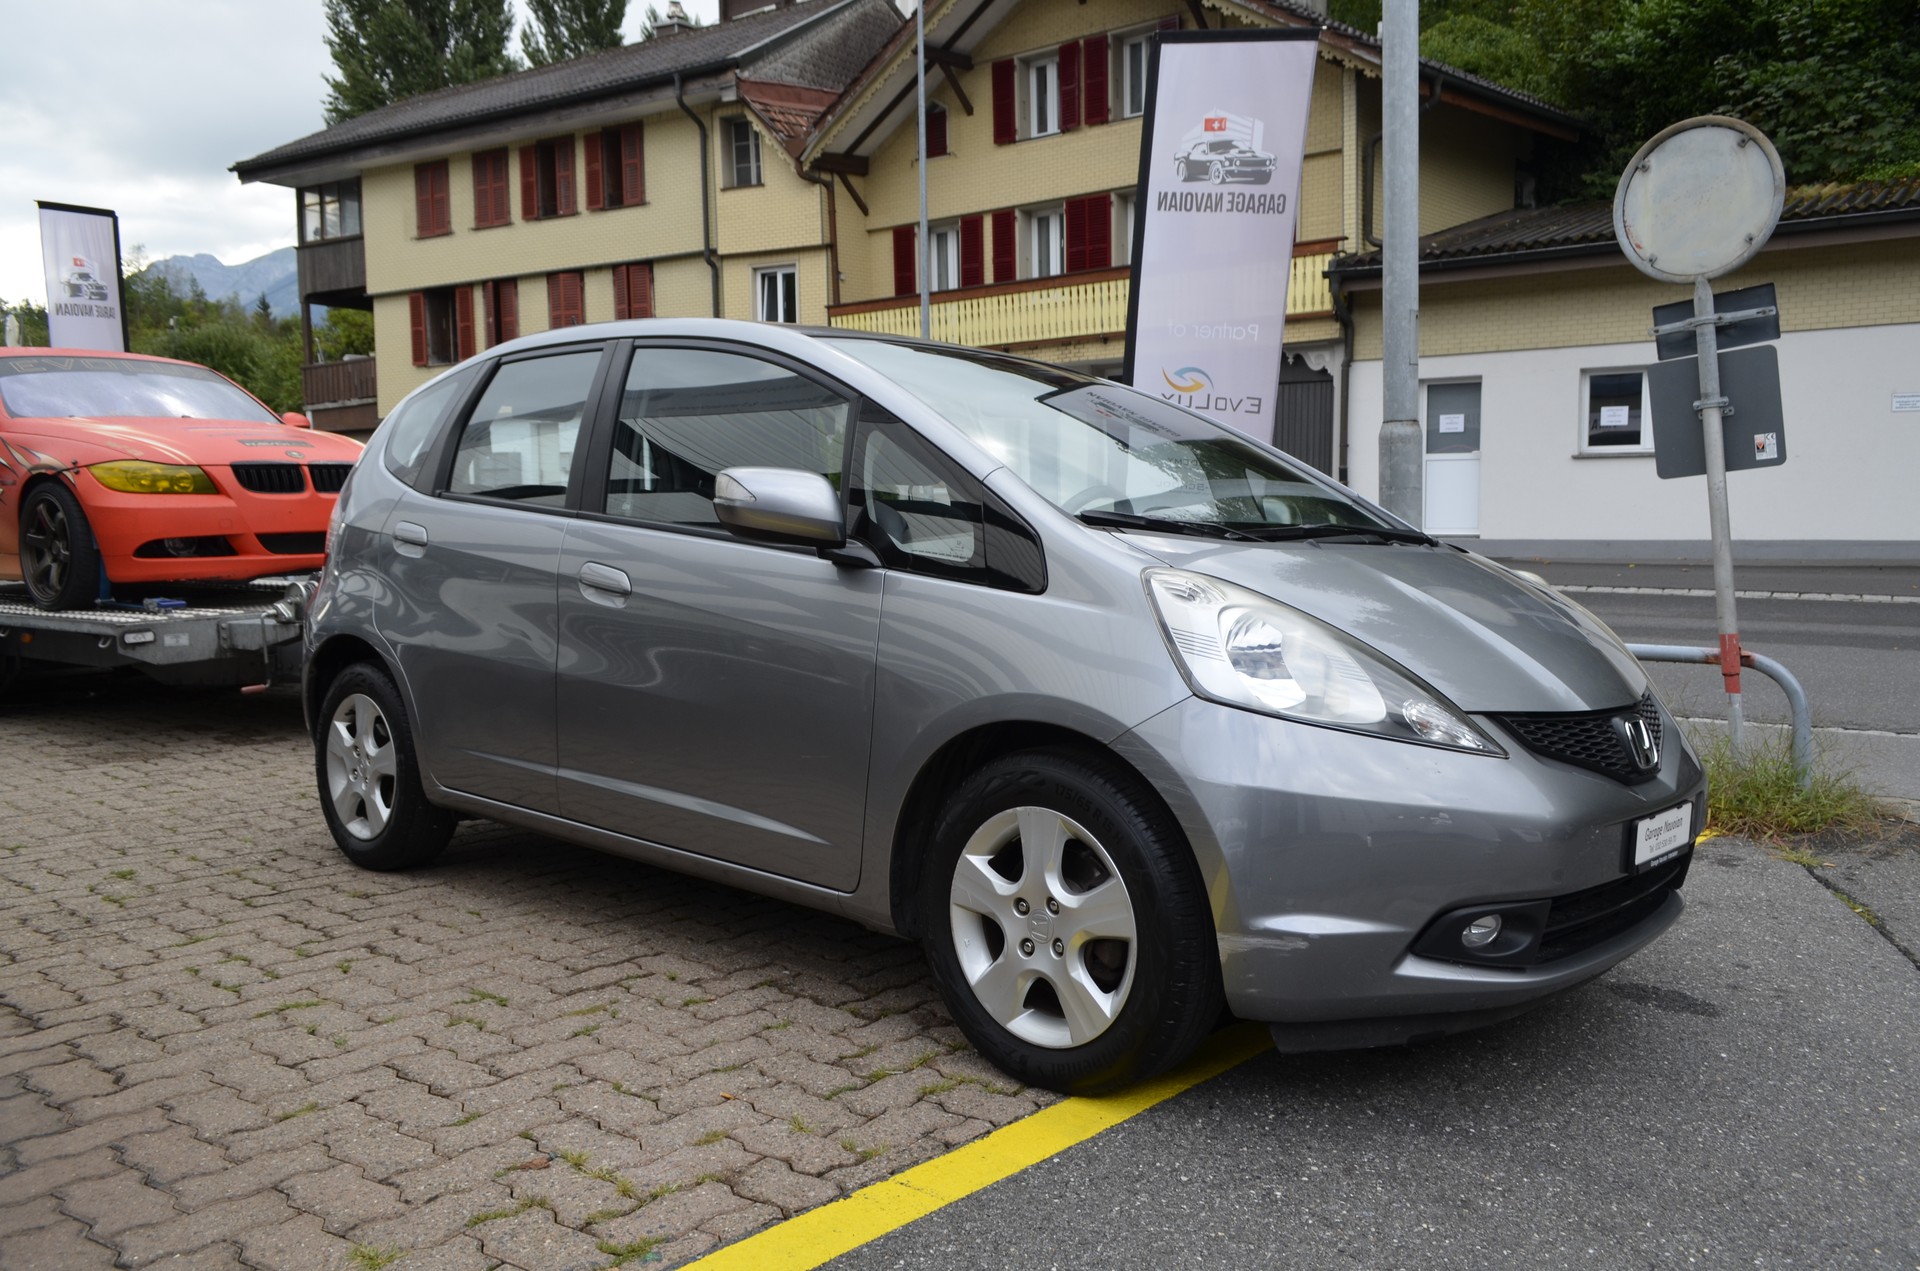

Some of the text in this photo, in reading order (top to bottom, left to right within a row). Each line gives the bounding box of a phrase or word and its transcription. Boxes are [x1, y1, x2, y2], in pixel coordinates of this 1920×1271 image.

[1055, 784, 1092, 812] 175/65
[1093, 808, 1102, 821] R
[1103, 817, 1114, 832] 15
[1645, 826, 1663, 841] Garage
